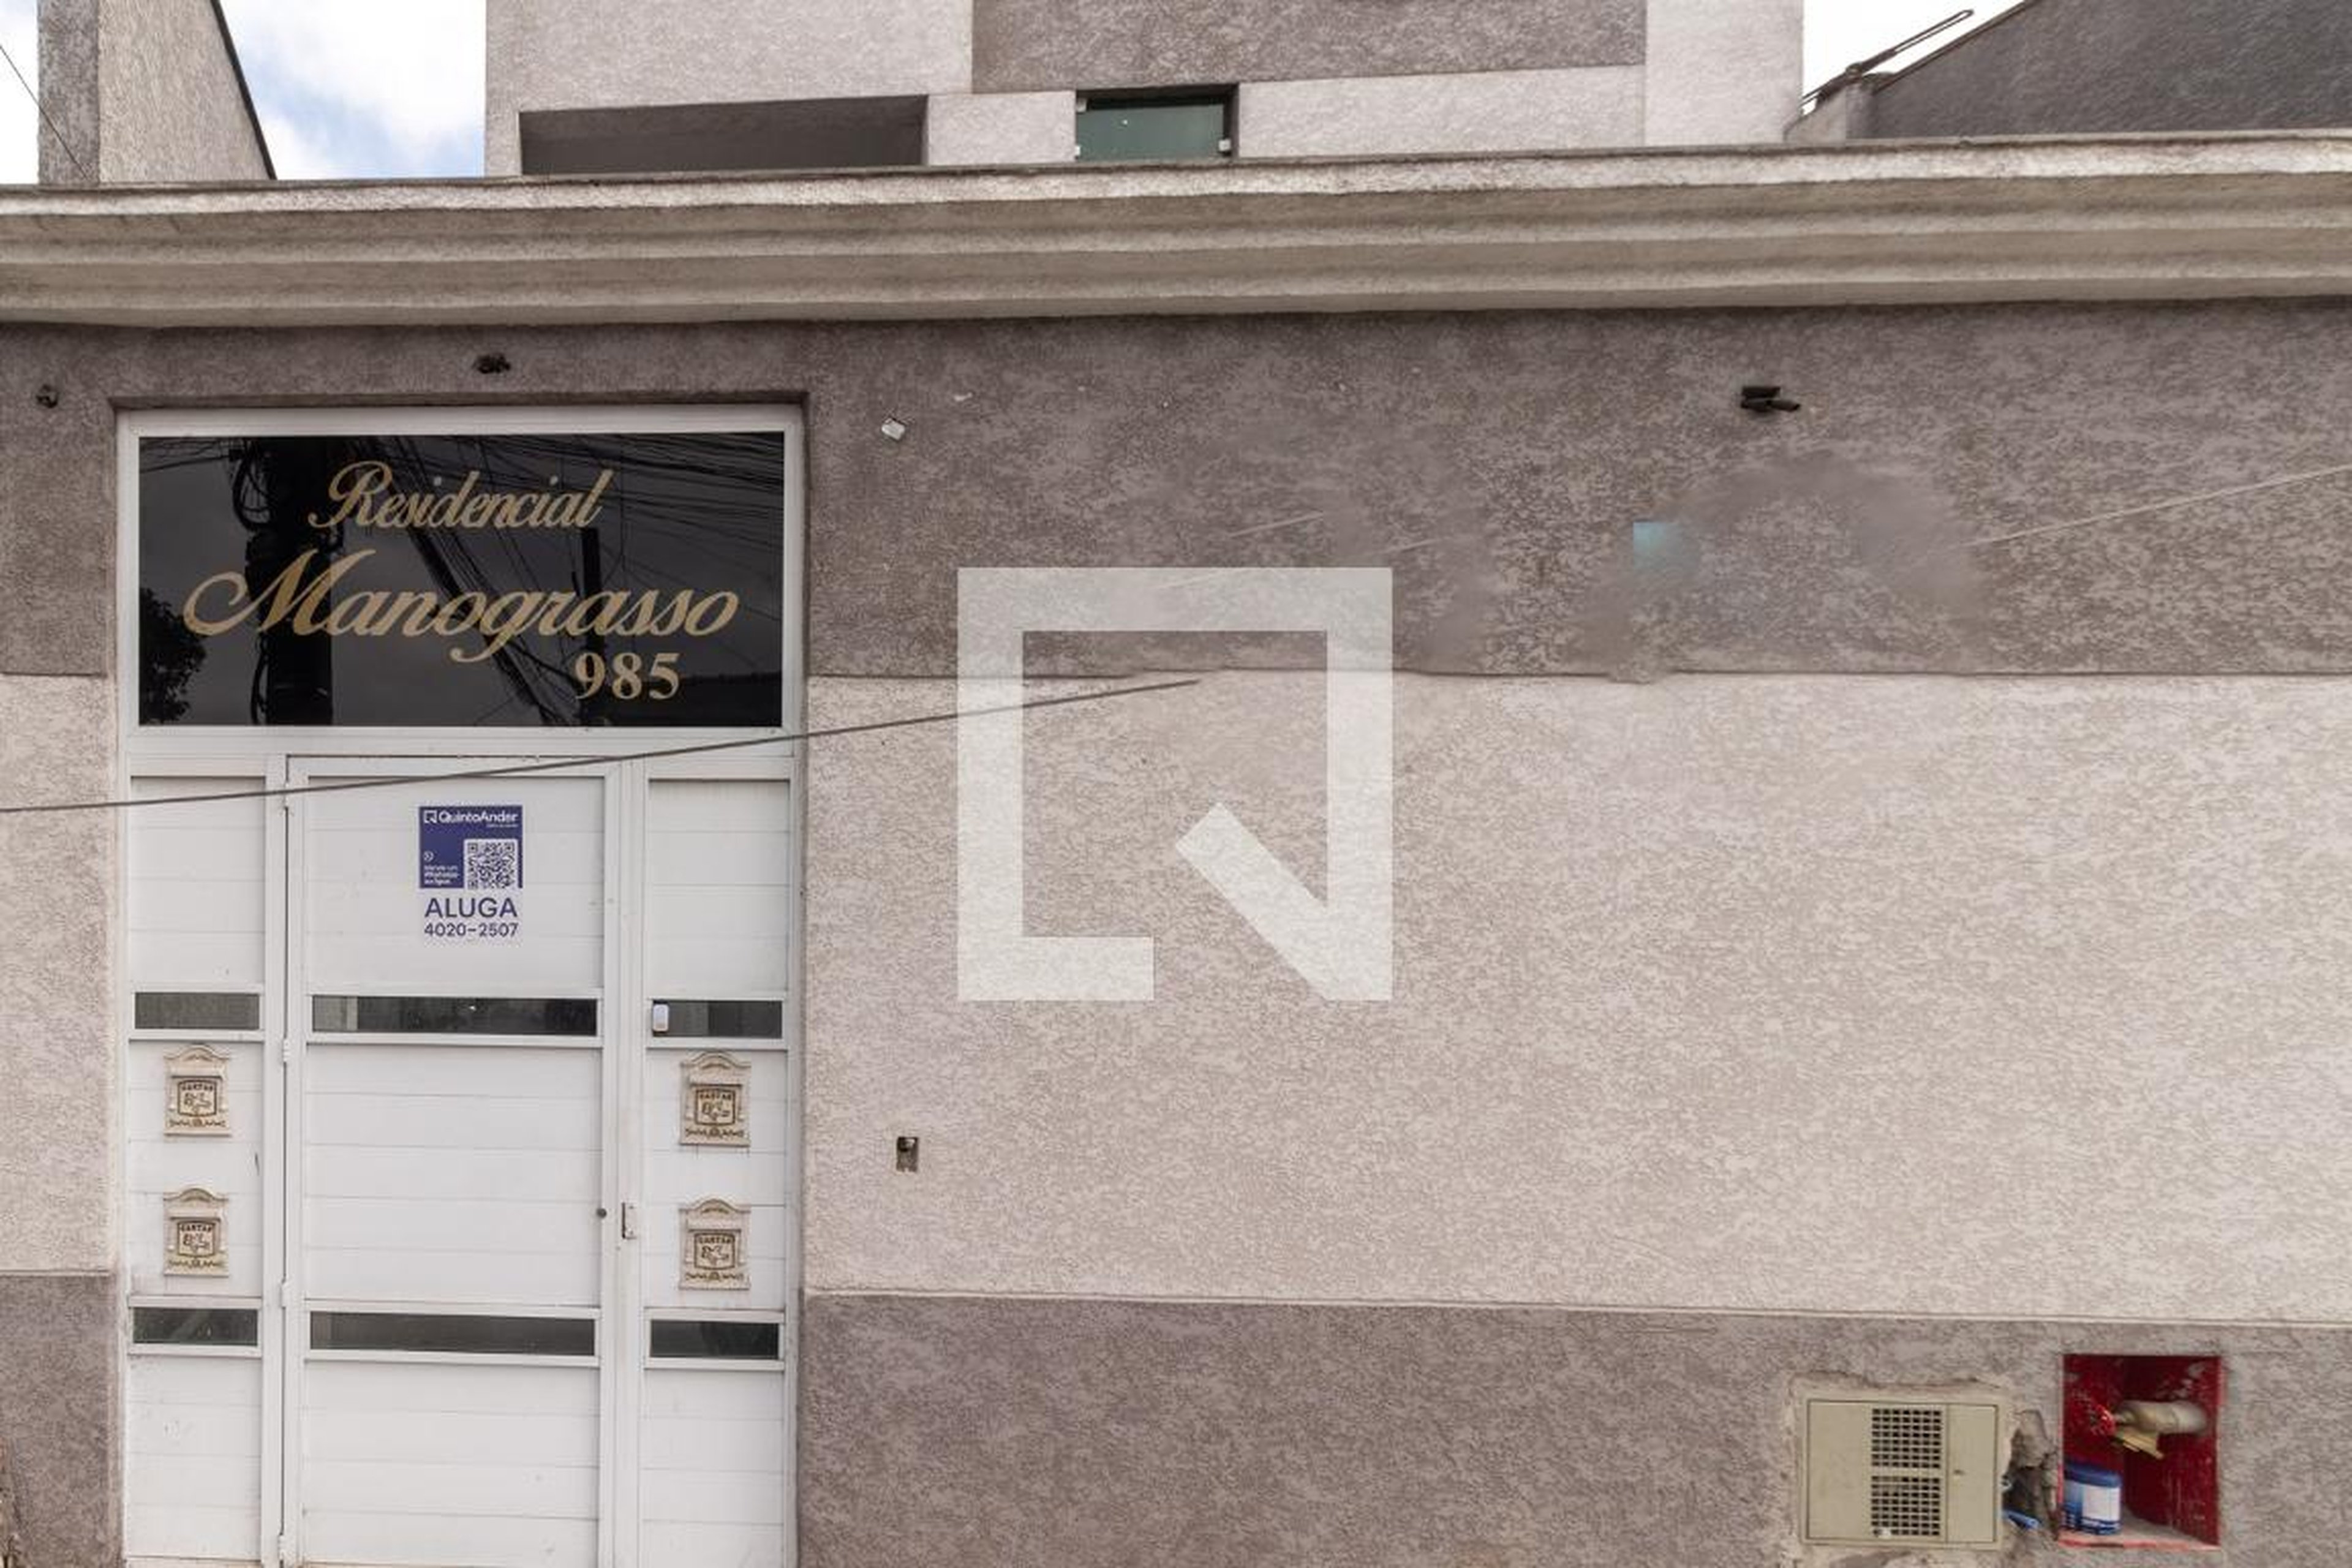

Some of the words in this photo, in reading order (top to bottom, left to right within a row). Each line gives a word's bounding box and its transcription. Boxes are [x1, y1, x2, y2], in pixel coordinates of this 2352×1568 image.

[307, 461, 613, 529] Residencial
[183, 549, 740, 663] Manograsso
[574, 652, 680, 699] 985
[424, 897, 518, 919] ALUGA
[424, 922, 519, 937] 4020-2507
